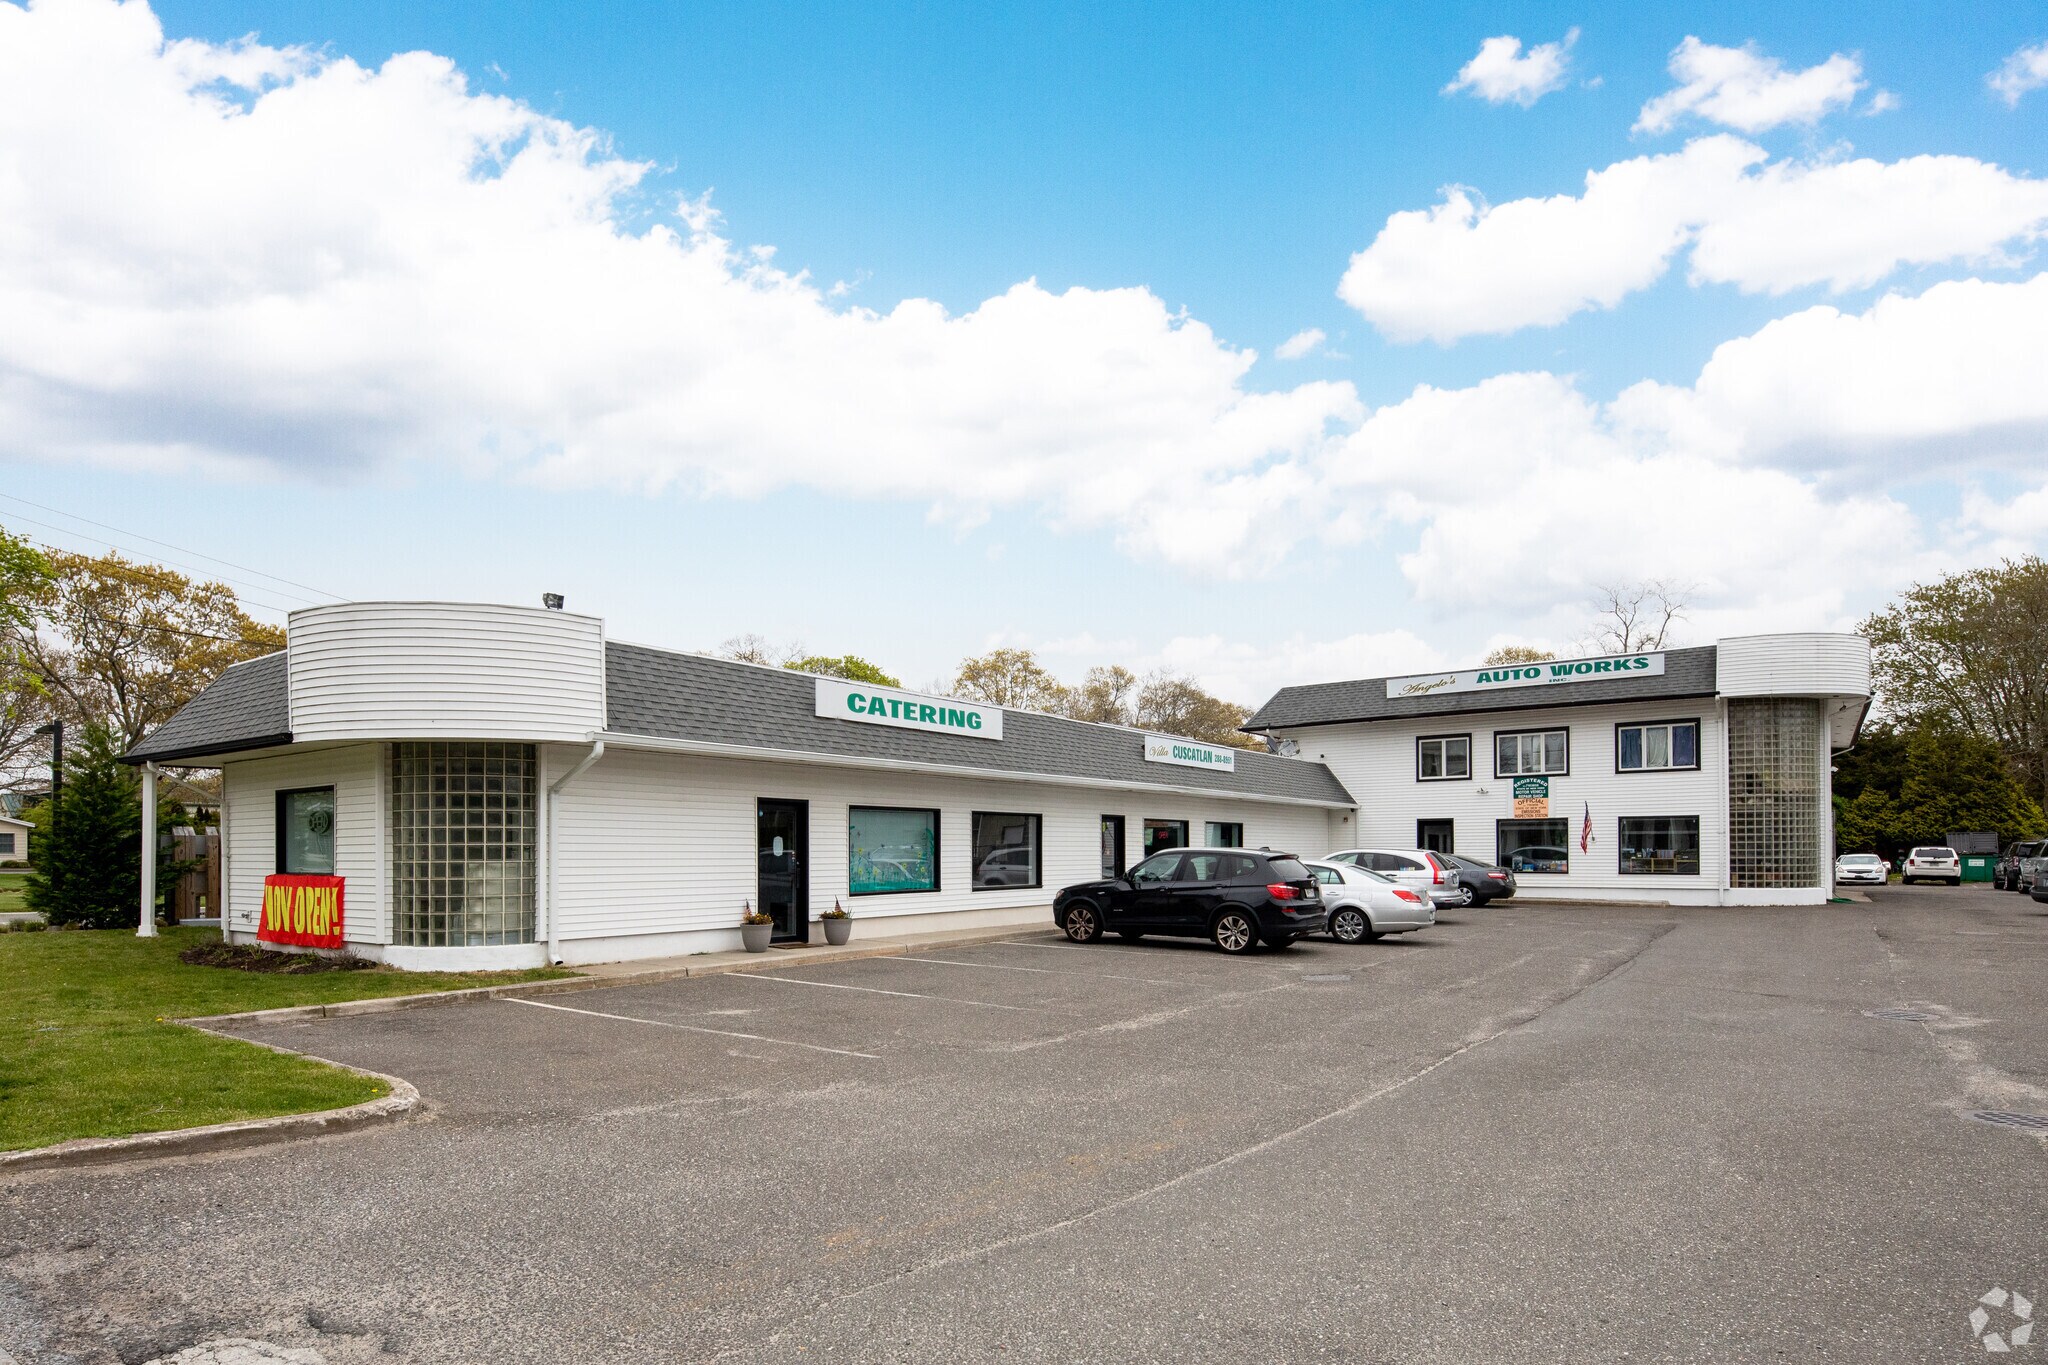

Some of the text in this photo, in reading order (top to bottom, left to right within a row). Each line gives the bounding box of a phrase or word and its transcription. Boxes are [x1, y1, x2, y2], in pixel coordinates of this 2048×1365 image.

[1398, 657, 1649, 695] Angelo's AUTO WORKS
[847, 693, 982, 730] CATERING
[1149, 744, 1169, 757] Villa
[1172, 745, 1213, 763] CUSCATLAN
[1514, 778, 1548, 788] REGISTERED
[294, 886, 341, 936] OPEN!
